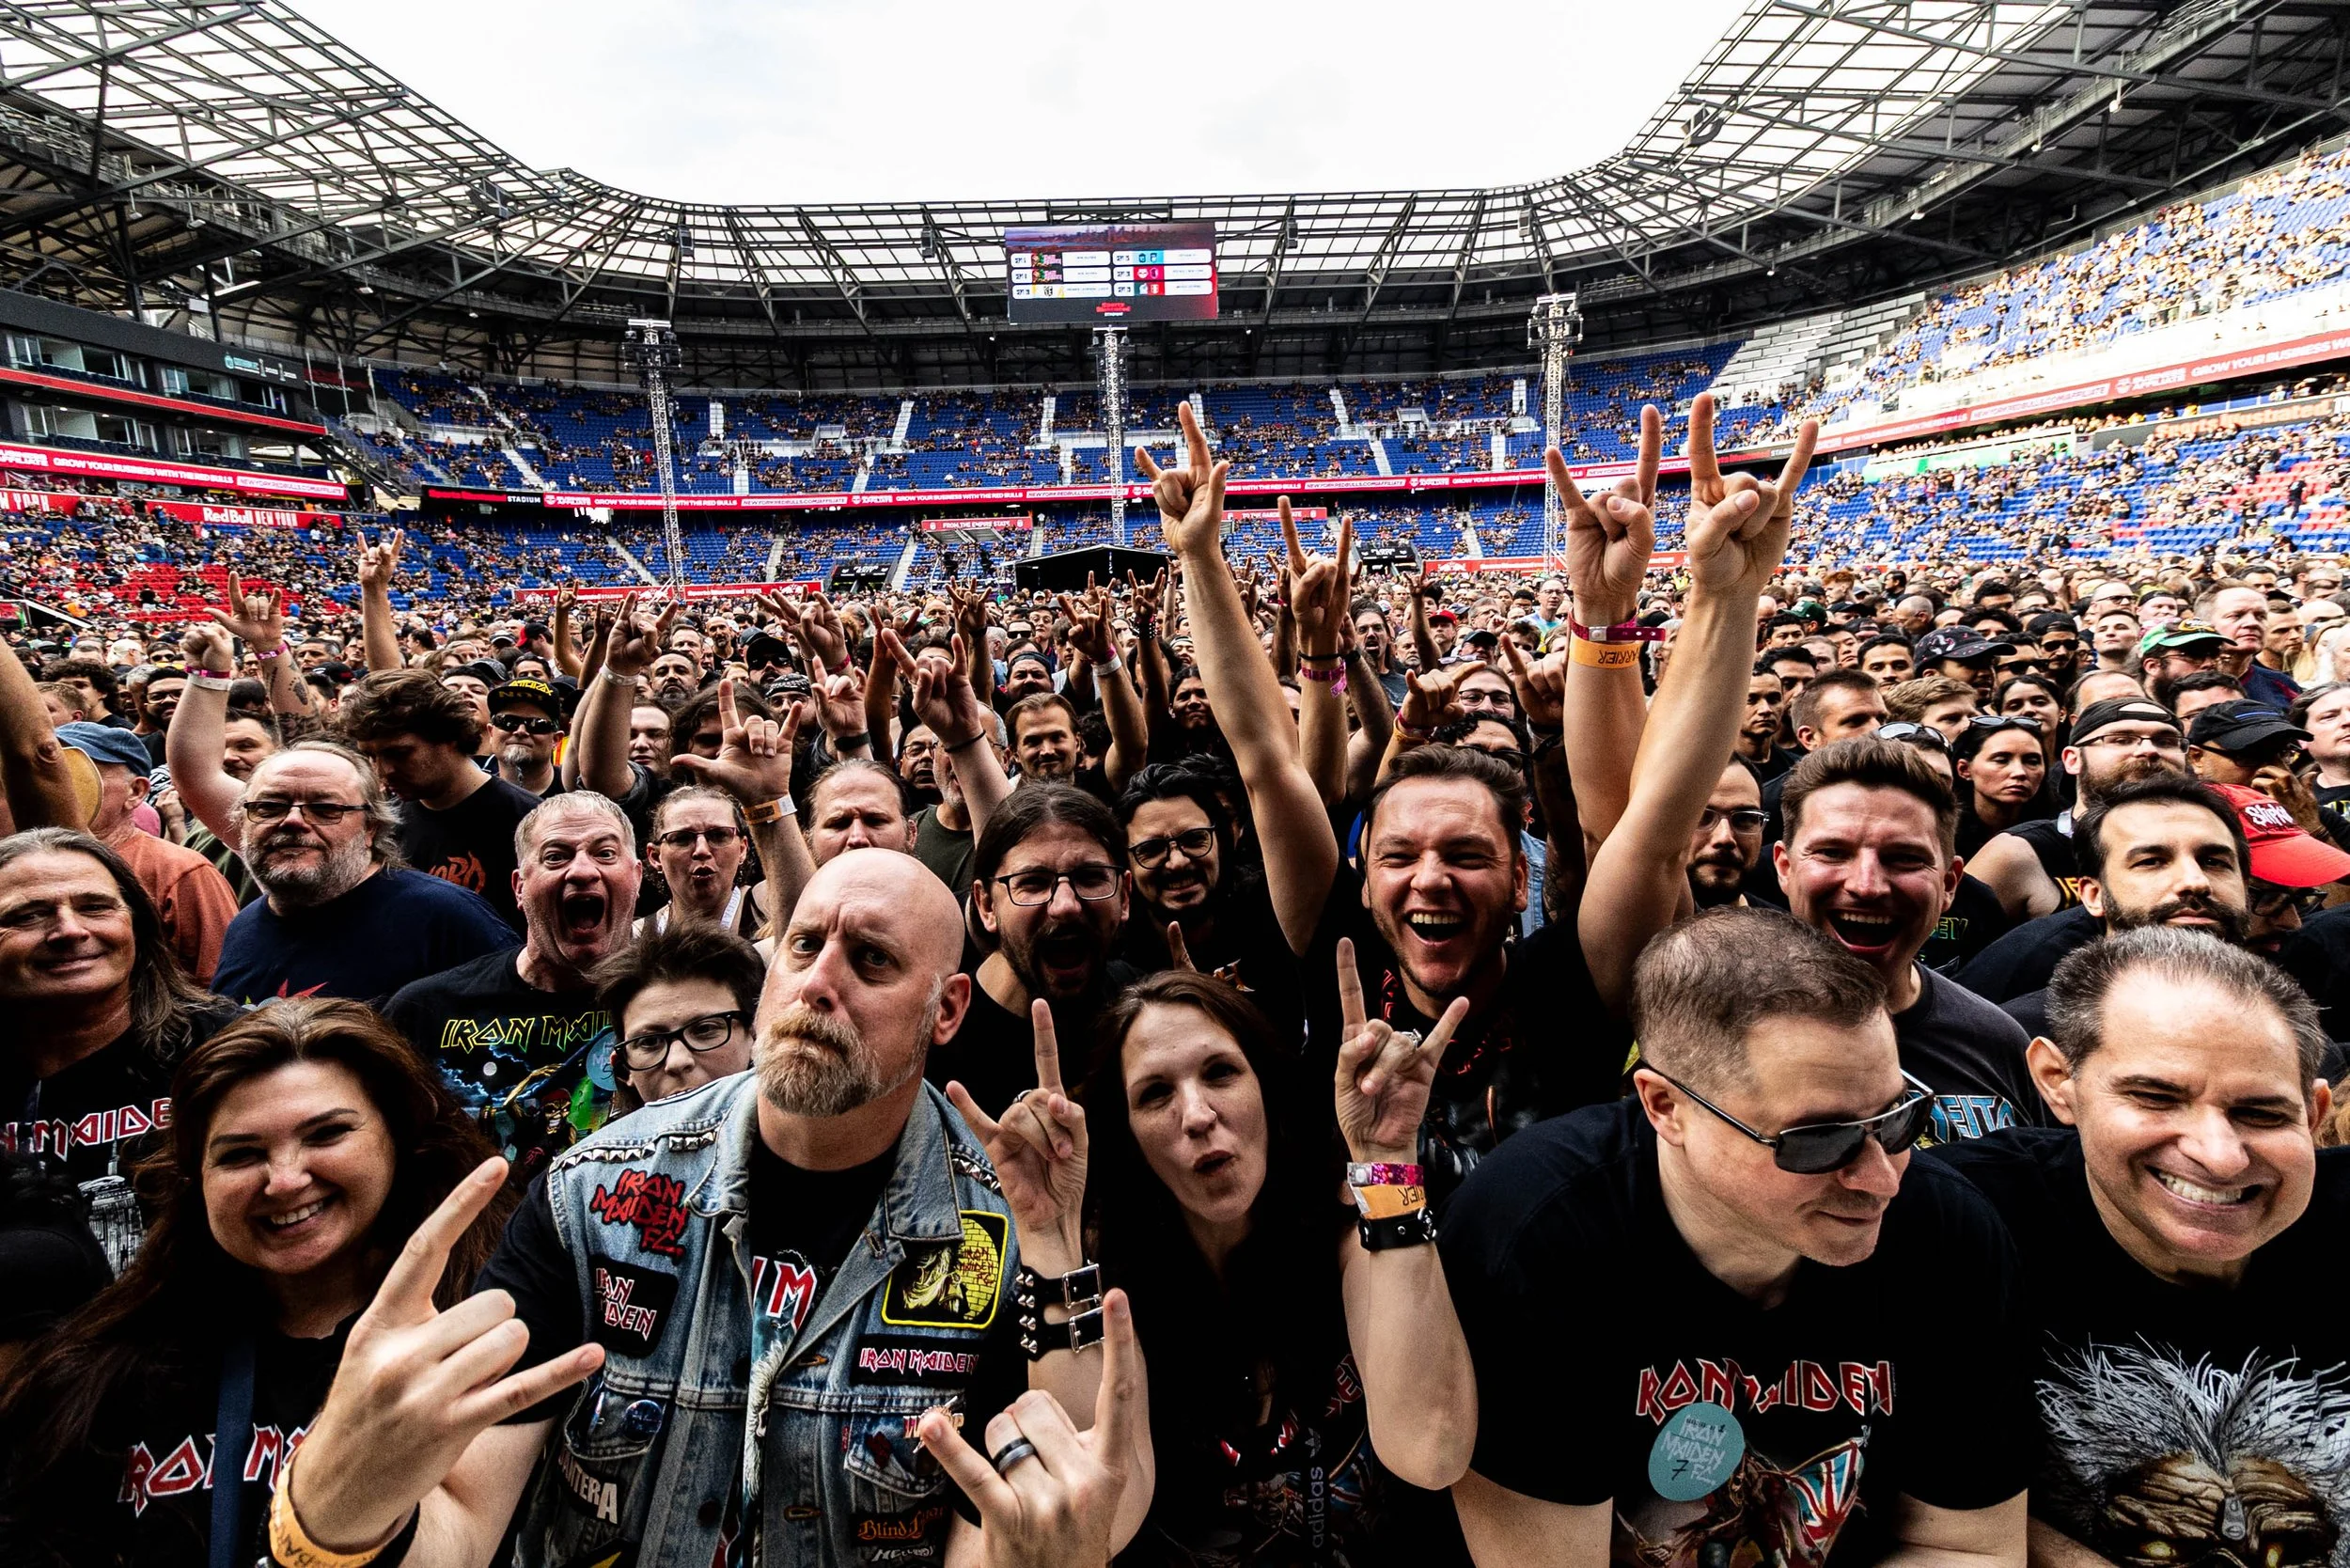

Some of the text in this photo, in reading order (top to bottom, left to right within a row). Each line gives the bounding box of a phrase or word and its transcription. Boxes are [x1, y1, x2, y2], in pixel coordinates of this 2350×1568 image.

[2191, 361, 2231, 378] GROW
[2231, 354, 2265, 370] YOUR
[2265, 340, 2331, 363] BUSINESS
[53, 456, 86, 469] GROW
[86, 460, 114, 471] YOUR
[507, 494, 540, 504] STADIUM
[202, 507, 228, 523] Red
[228, 508, 254, 525] Bull
[441, 1011, 611, 1055] IRON MAI
[33, 1097, 173, 1162] MAIDE
[617, 1169, 684, 1205] IRON
[591, 1184, 688, 1234] MAIDEN
[859, 1347, 979, 1377] IRON MAIDEN
[1671, 1459, 1689, 1482] 7
[1307, 1466, 1324, 1549] adidas
[856, 1519, 907, 1541] Blind
